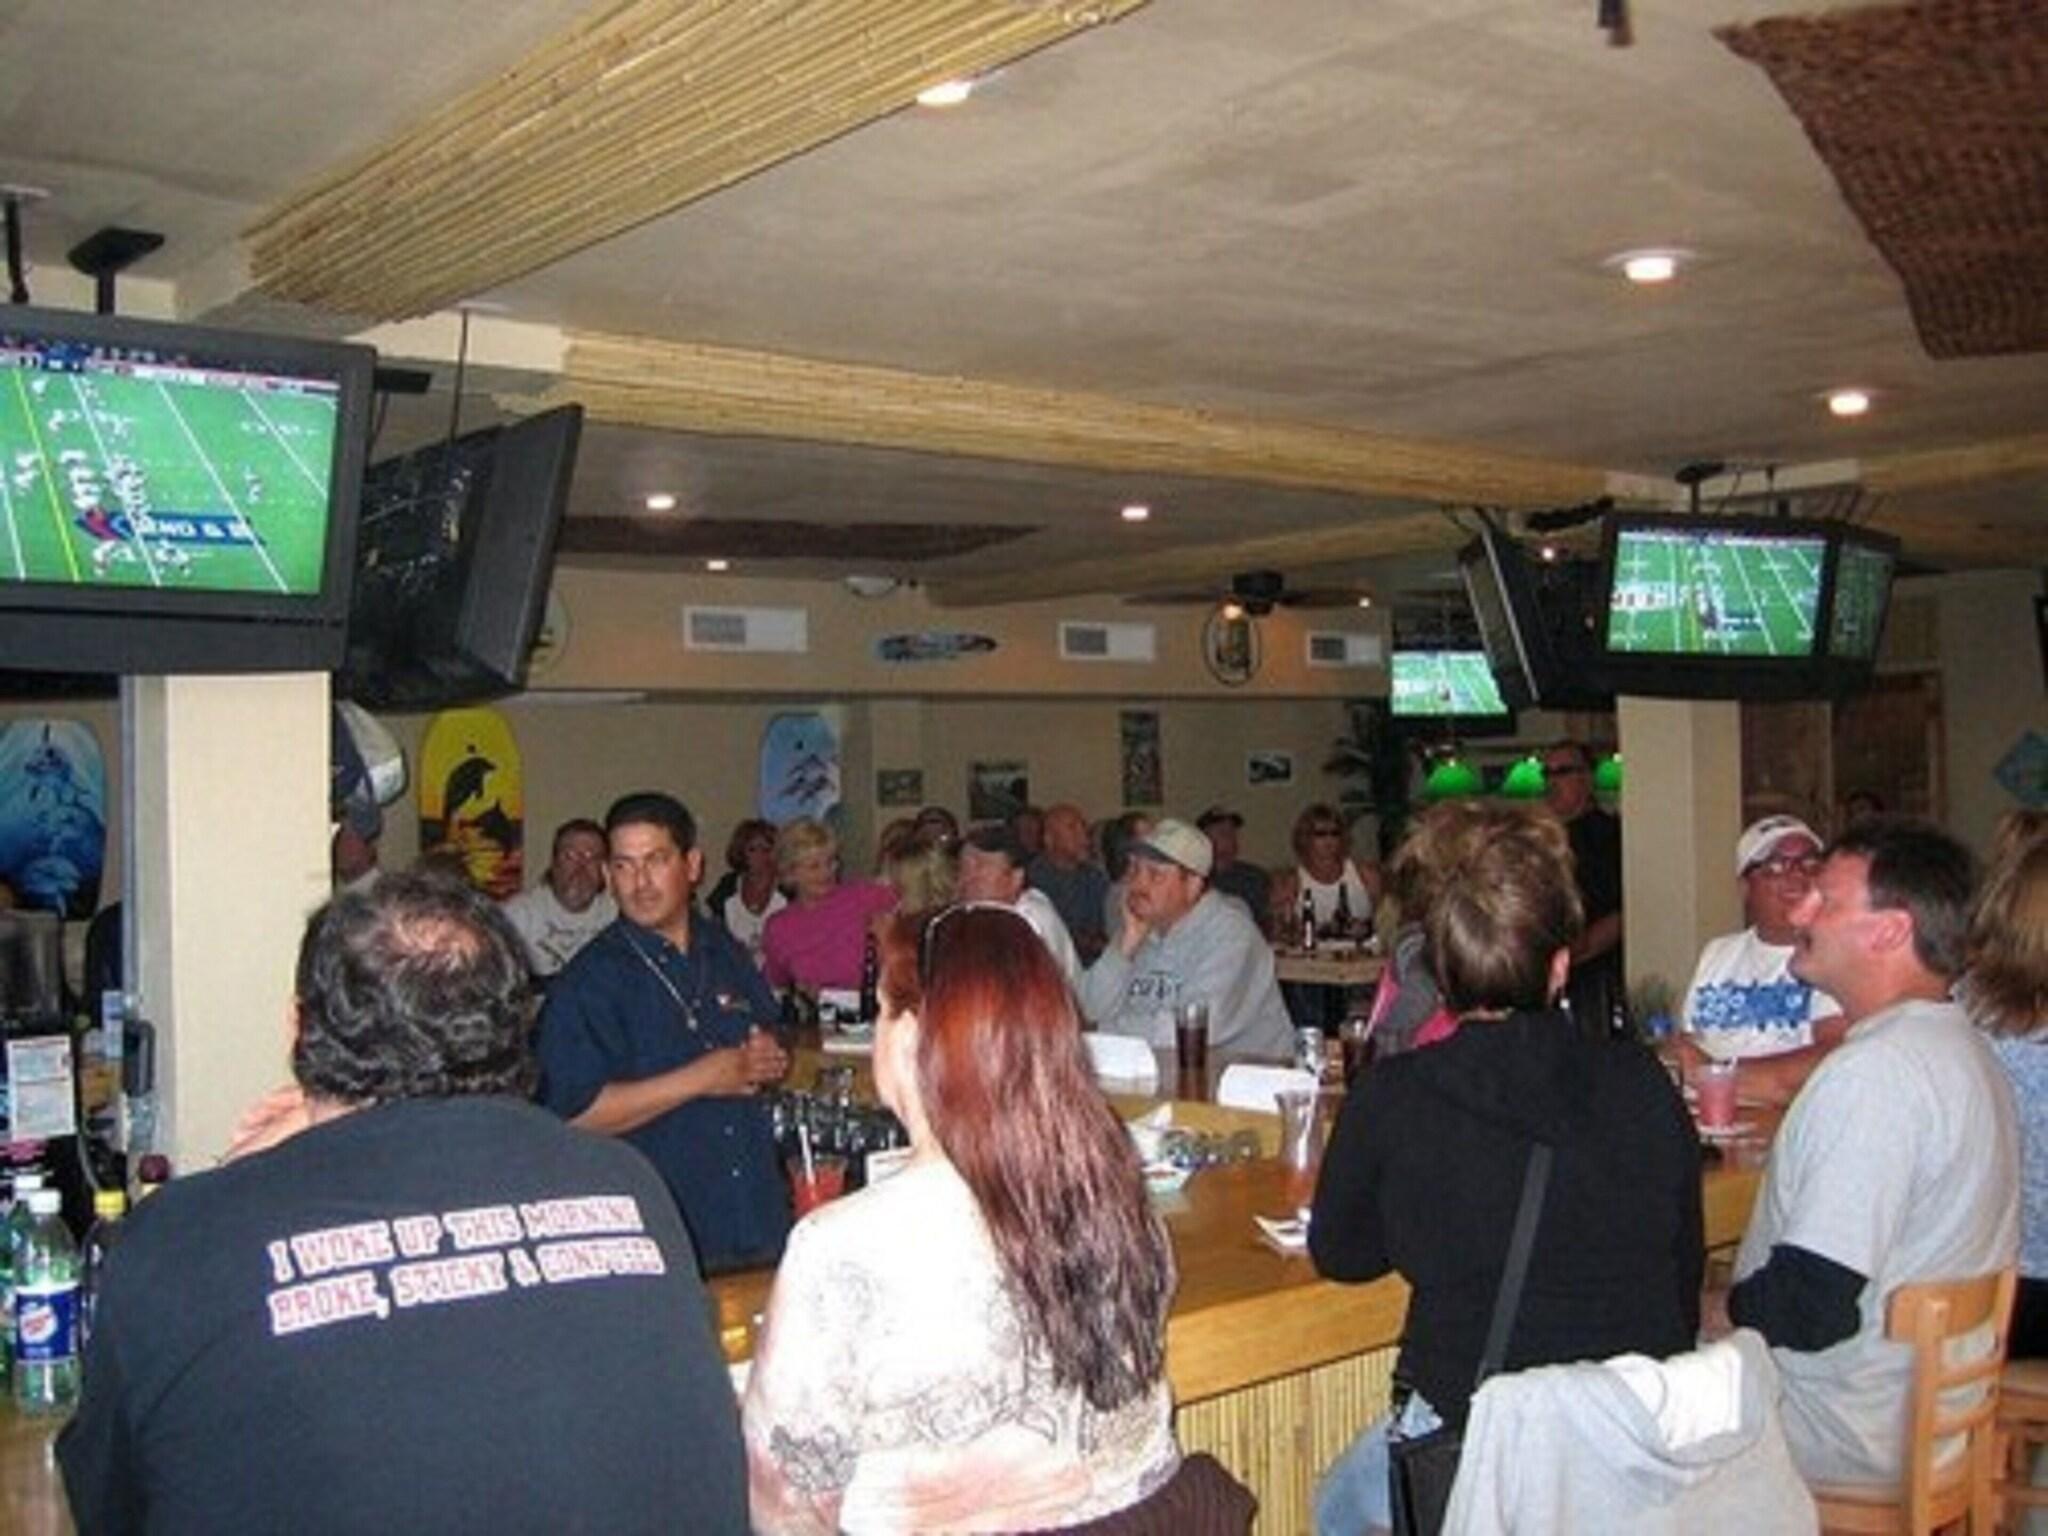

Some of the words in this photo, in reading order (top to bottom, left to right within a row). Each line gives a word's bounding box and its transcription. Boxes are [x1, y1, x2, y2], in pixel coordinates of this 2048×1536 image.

[267, 1240, 294, 1282] I
[290, 1219, 394, 1276] WOKE
[393, 1214, 443, 1257] UP
[442, 1205, 525, 1250] THIS
[267, 1270, 390, 1335] BROKE,
[388, 1251, 509, 1308] STICKY
[507, 1248, 541, 1288] &
